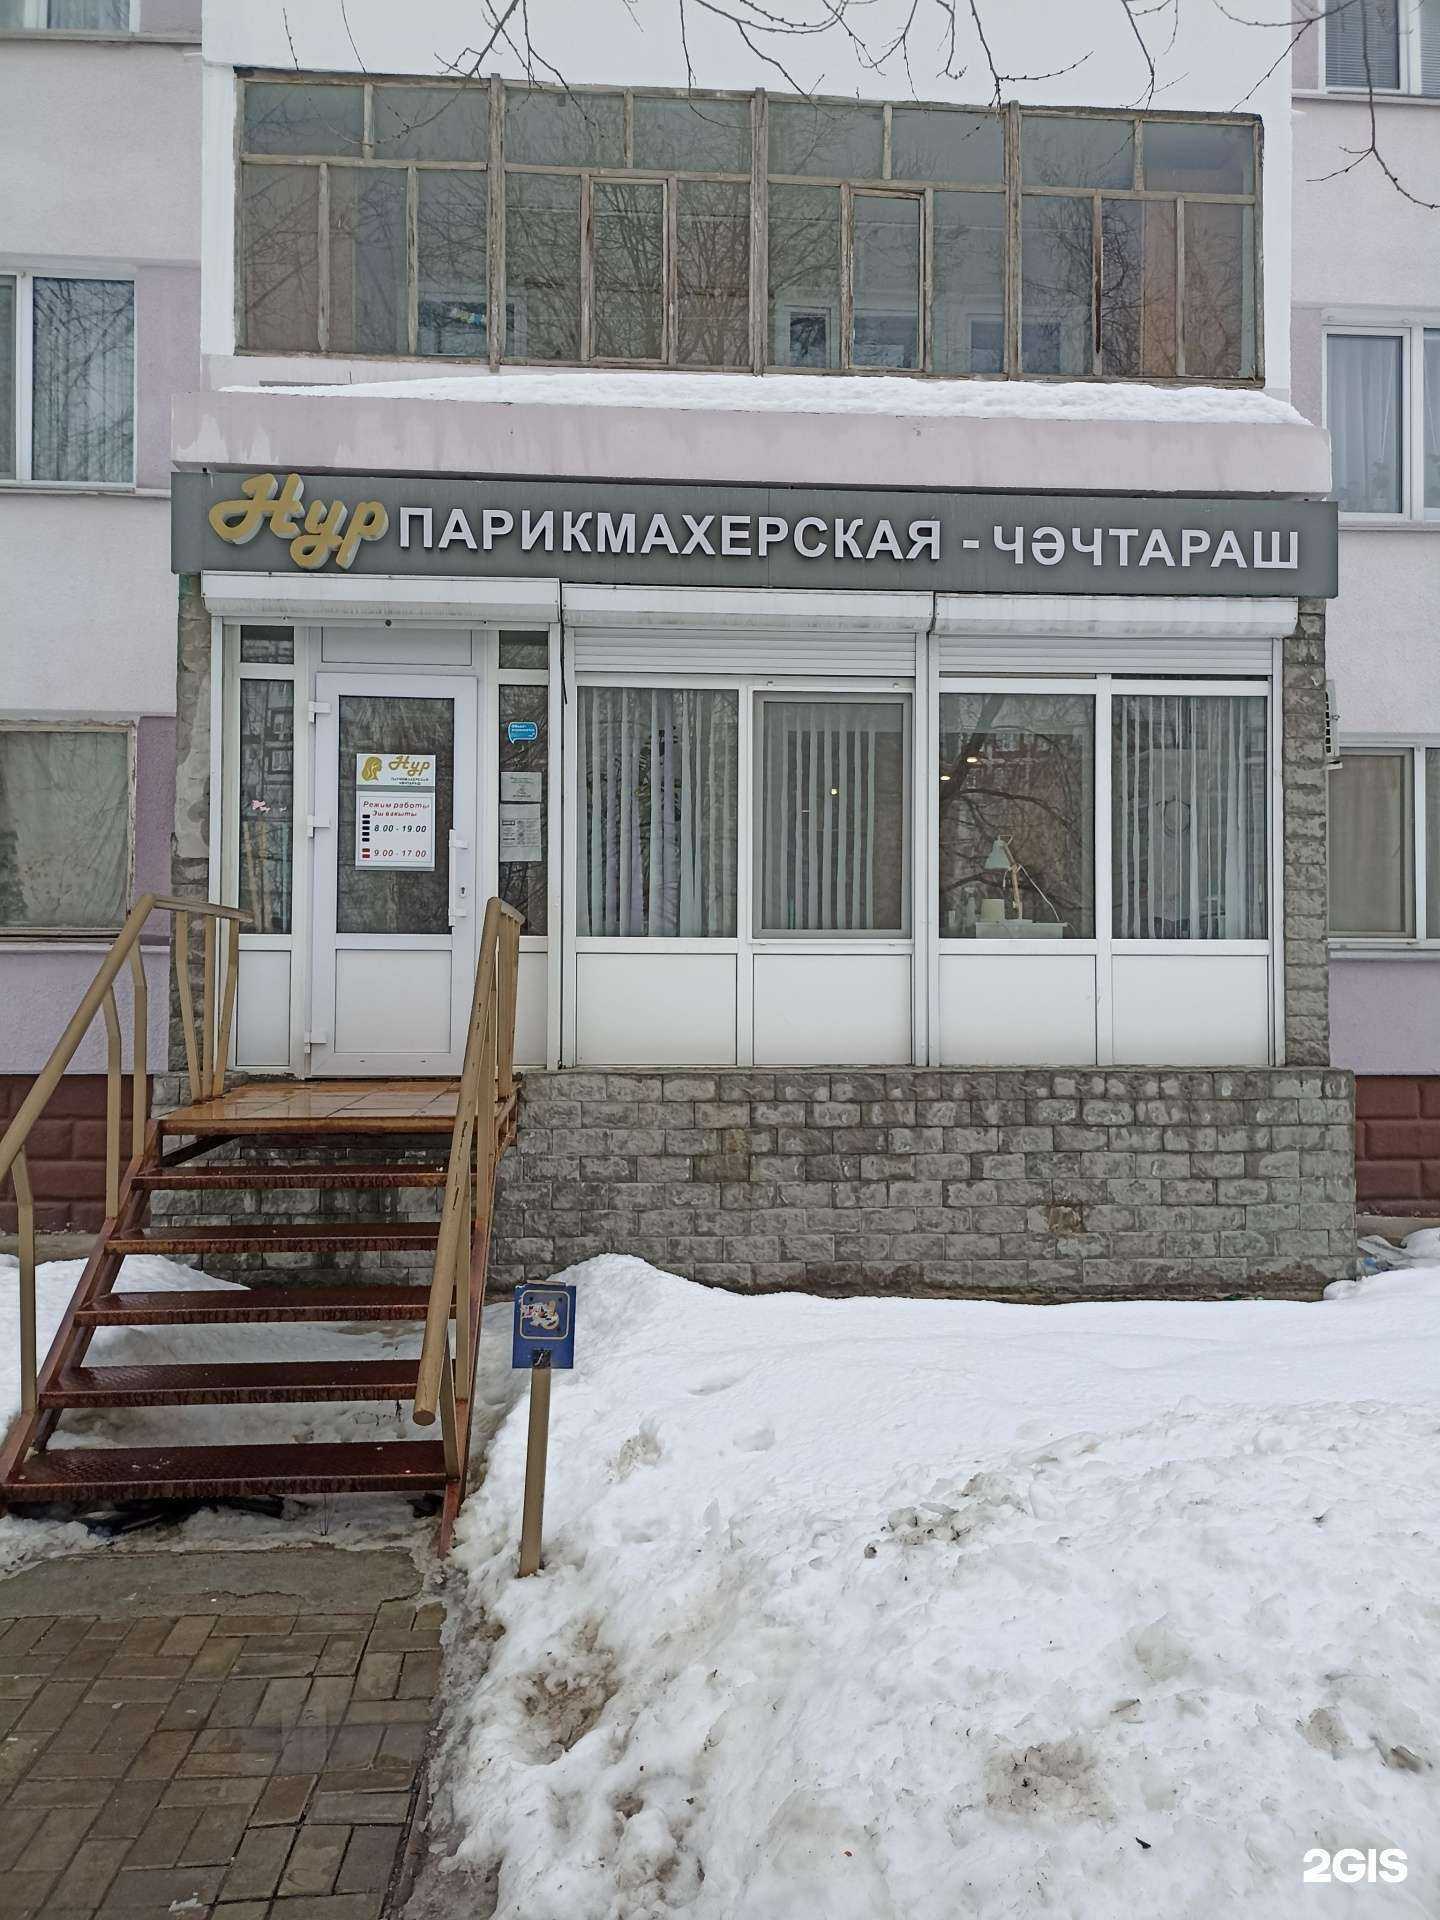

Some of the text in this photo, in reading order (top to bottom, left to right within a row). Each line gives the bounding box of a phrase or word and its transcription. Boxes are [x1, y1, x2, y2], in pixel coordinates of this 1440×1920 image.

[208, 473, 390, 570] Нур
[399, 506, 943, 561] ПАРИКМАХЕРСКАЯ
[993, 525, 1300, 570] ЧӘЧТАРАШ
[388, 755, 430, 777] Нур
